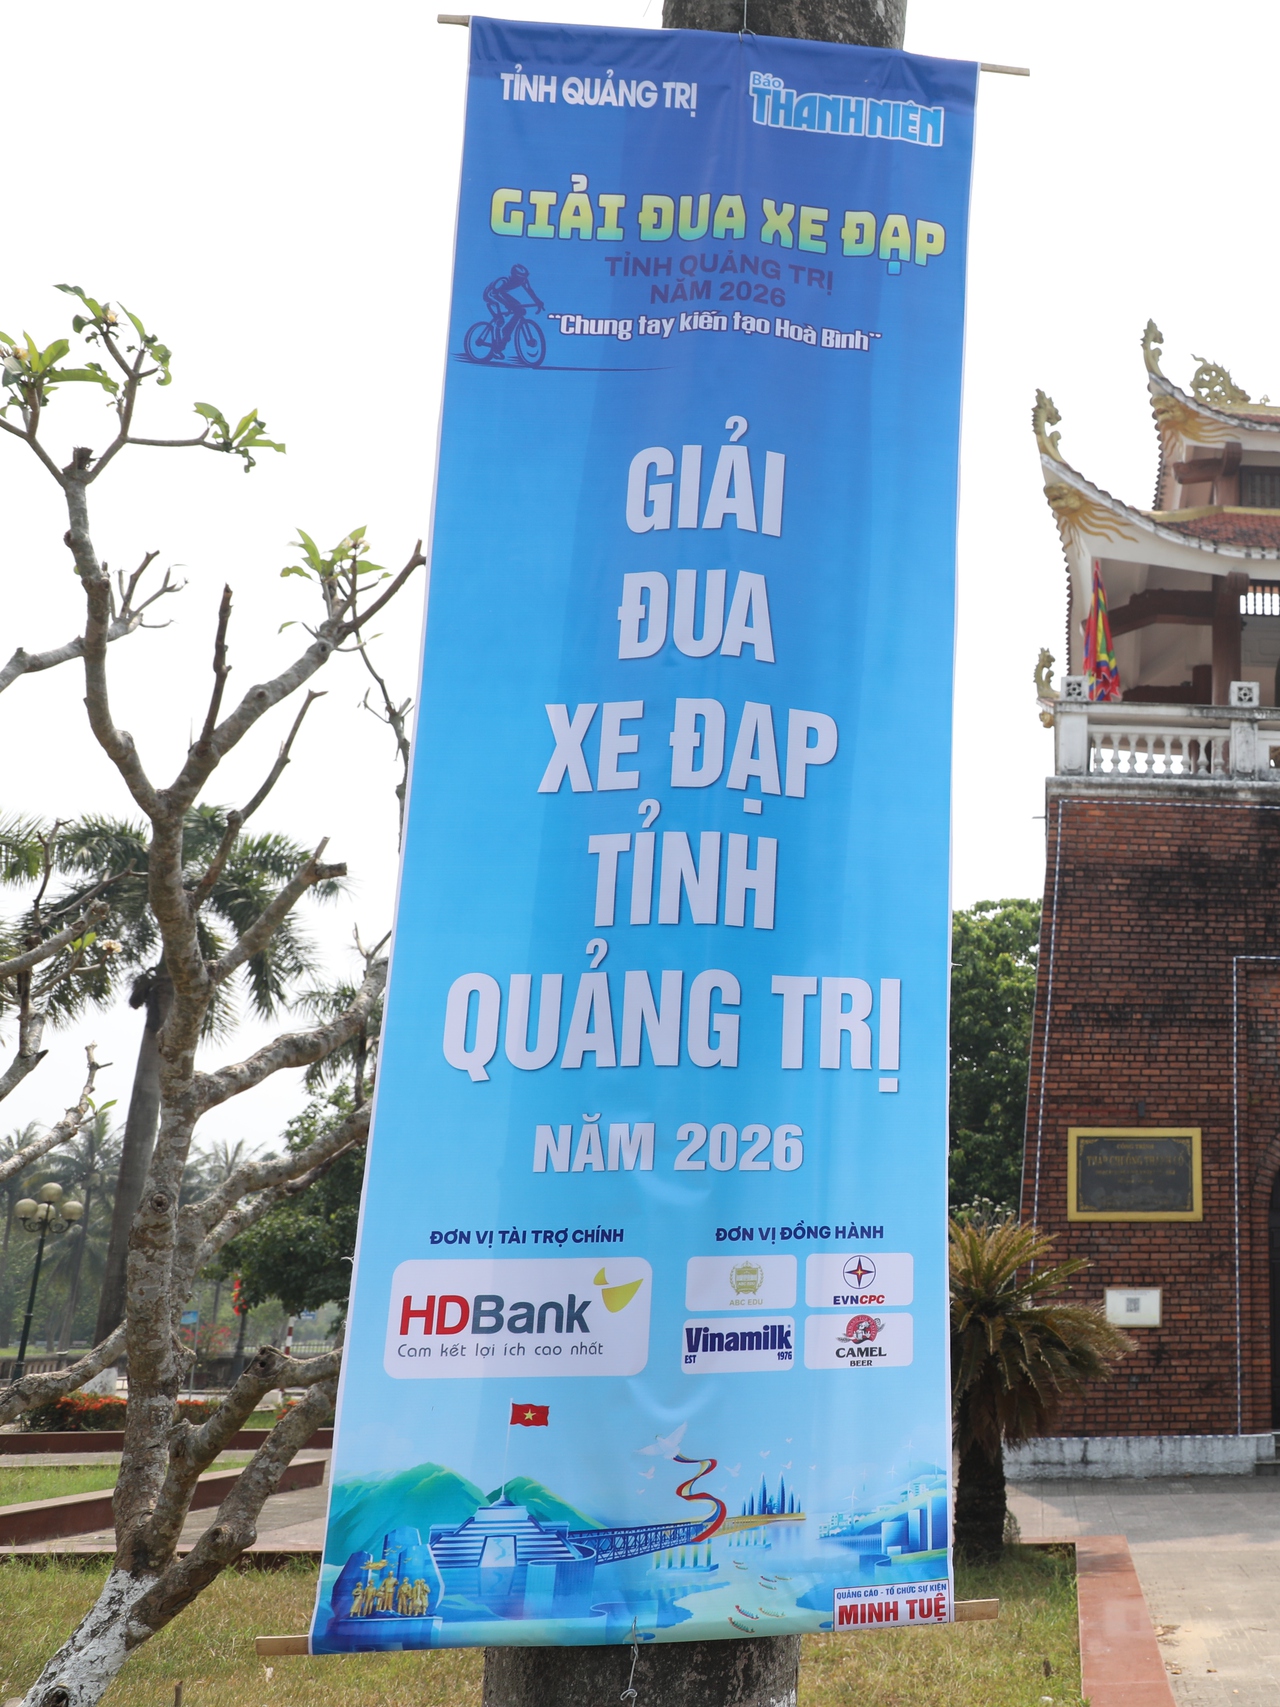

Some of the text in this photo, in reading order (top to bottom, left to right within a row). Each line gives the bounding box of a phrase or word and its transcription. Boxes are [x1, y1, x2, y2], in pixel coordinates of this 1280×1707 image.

[500, 63, 698, 117] TỈNH QUẢNG TRỊ
[751, 72, 783, 89] Báo
[750, 86, 945, 147] THANH NIÊN
[489, 173, 946, 276] GIẢI ĐUA XE ĐẠP
[605, 249, 834, 296] TỈNH QUẢNG TRỊ
[650, 278, 786, 307] NĂM 2026
[638, 315, 675, 338] tay
[679, 311, 728, 332] kiến
[732, 310, 771, 335] tạo
[774, 317, 817, 346] Hoà
[625, 415, 786, 537] GIẢI
[617, 569, 775, 663] ĐUA
[537, 698, 838, 814] XE ĐẠP
[588, 798, 778, 930] TỈNH
[442, 937, 901, 1093] QUẢNG TRỊ
[532, 1113, 804, 1173] NĂM 2026
[430, 1225, 624, 1248] ĐƠN VỊ TÀI TRỢ CHÍNH
[715, 1220, 884, 1245] ĐƠN VỊ ĐỒNG HÀNH
[399, 1294, 592, 1335] HDBank
[748, 1298, 763, 1306] EDU
[833, 1294, 885, 1305] EVNCPC
[397, 1341, 603, 1359] Cam kết lợi ích cao nhất
[685, 1325, 792, 1352] Vinamilk
[835, 1347, 887, 1358] CAMEL
[685, 1351, 792, 1364] EST 1976
[836, 1589, 862, 1600] QUẢNG
[864, 1589, 878, 1597] CÁO
[896, 1584, 916, 1594] CHỨC
[917, 1584, 928, 1594] SỰ
[930, 1583, 947, 1593] KIỆN
[838, 1593, 947, 1625] MINH TUỆ
